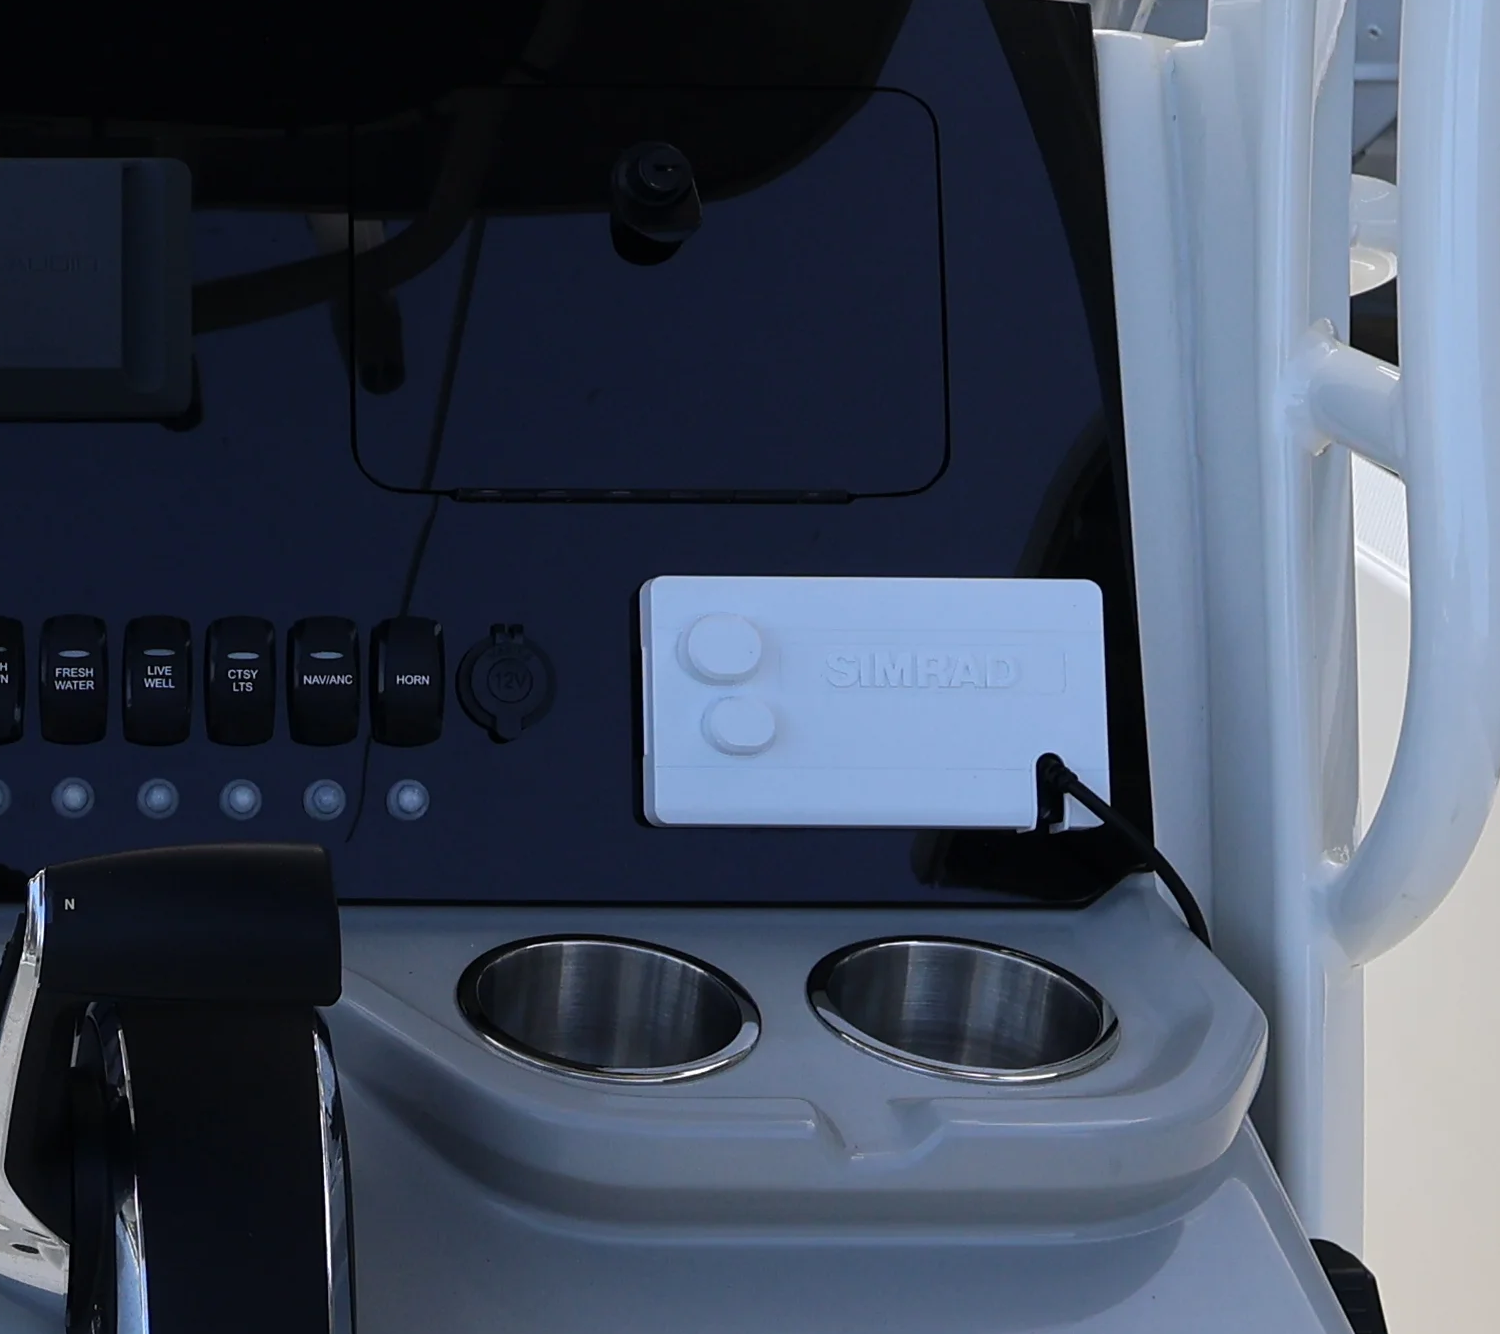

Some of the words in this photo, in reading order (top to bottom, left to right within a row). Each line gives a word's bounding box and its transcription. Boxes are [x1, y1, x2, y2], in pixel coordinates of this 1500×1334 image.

[55, 668, 94, 679] FRESH
[147, 666, 172, 676] LIVE
[227, 669, 258, 680] CTSY
[823, 651, 1021, 690] SIMRAD
[54, 680, 95, 691] WATER
[143, 678, 175, 689] WELL
[303, 675, 353, 685] NAV/ANC
[396, 675, 430, 686] HORN
[495, 671, 527, 690] 12V
[233, 681, 253, 693] LTS
[64, 898, 76, 910] N
